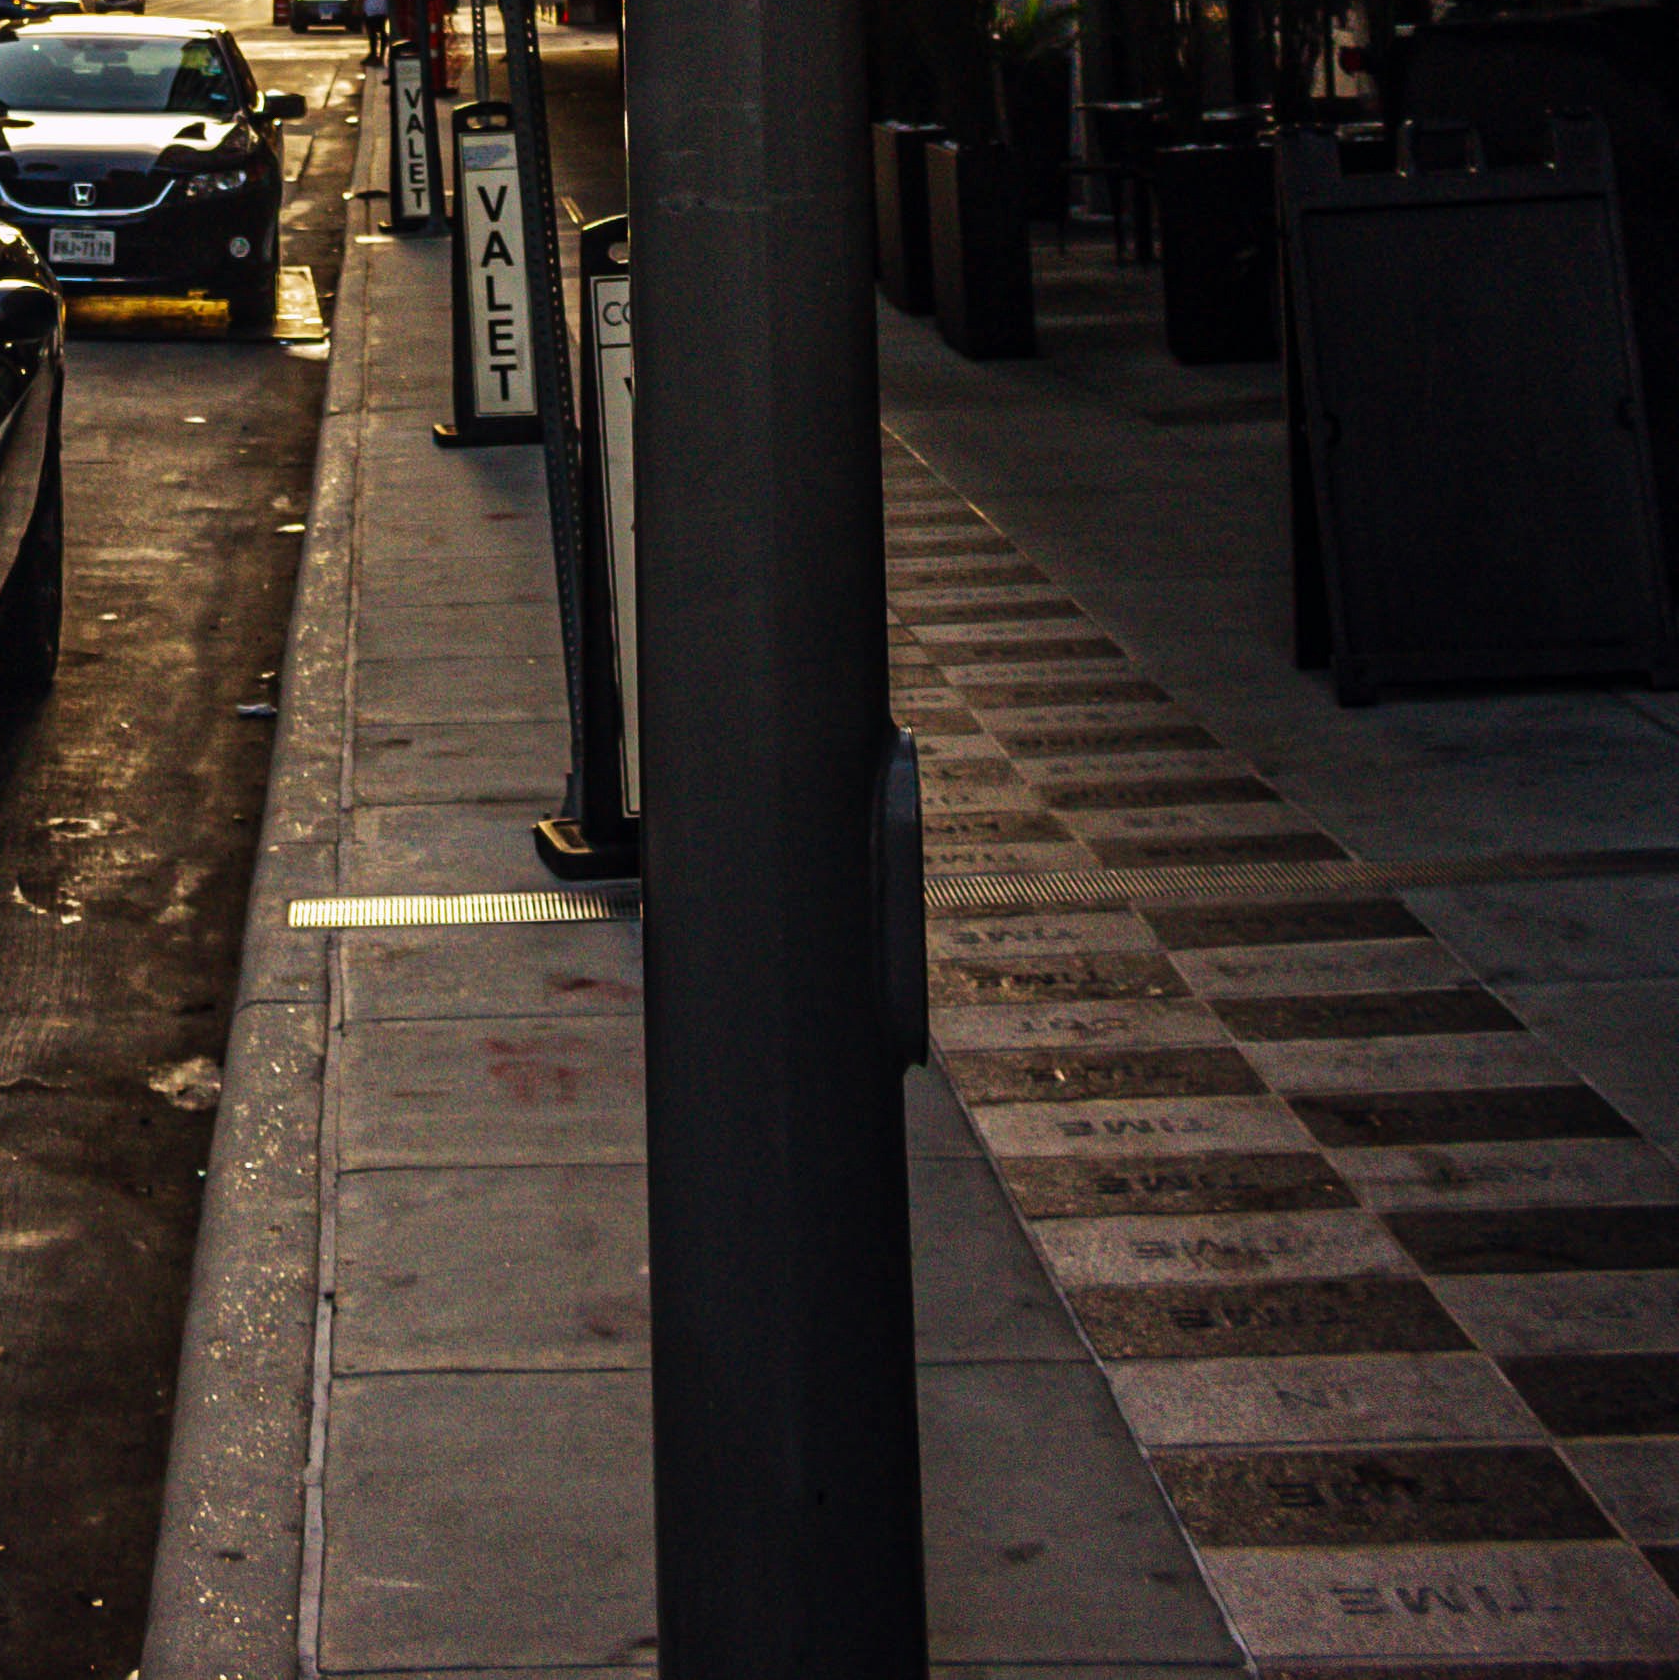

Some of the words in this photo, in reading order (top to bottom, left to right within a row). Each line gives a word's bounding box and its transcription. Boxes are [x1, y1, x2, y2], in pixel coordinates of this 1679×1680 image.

[404, 88, 427, 210] VALET
[477, 185, 518, 401] VALET
[1169, 1306, 1361, 1330] TIME
[1328, 1585, 1568, 1616] TIME
